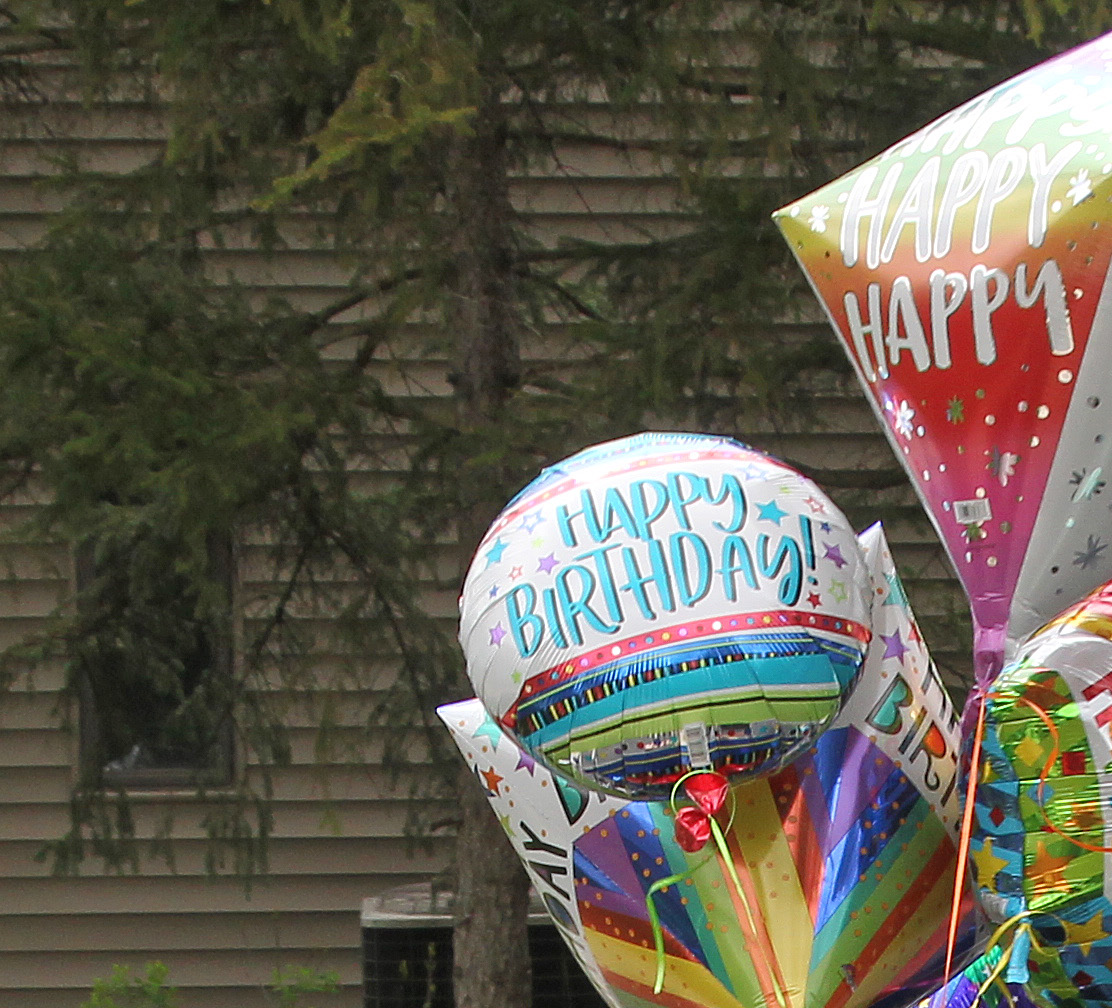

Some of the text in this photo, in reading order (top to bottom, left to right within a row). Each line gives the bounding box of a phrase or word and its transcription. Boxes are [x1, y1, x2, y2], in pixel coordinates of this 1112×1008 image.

[840, 141, 1083, 270] HAPPY
[845, 257, 1075, 381] HAPPY
[556, 472, 747, 547] HAPPY
[505, 514, 817, 658] BIRTHDAY!
